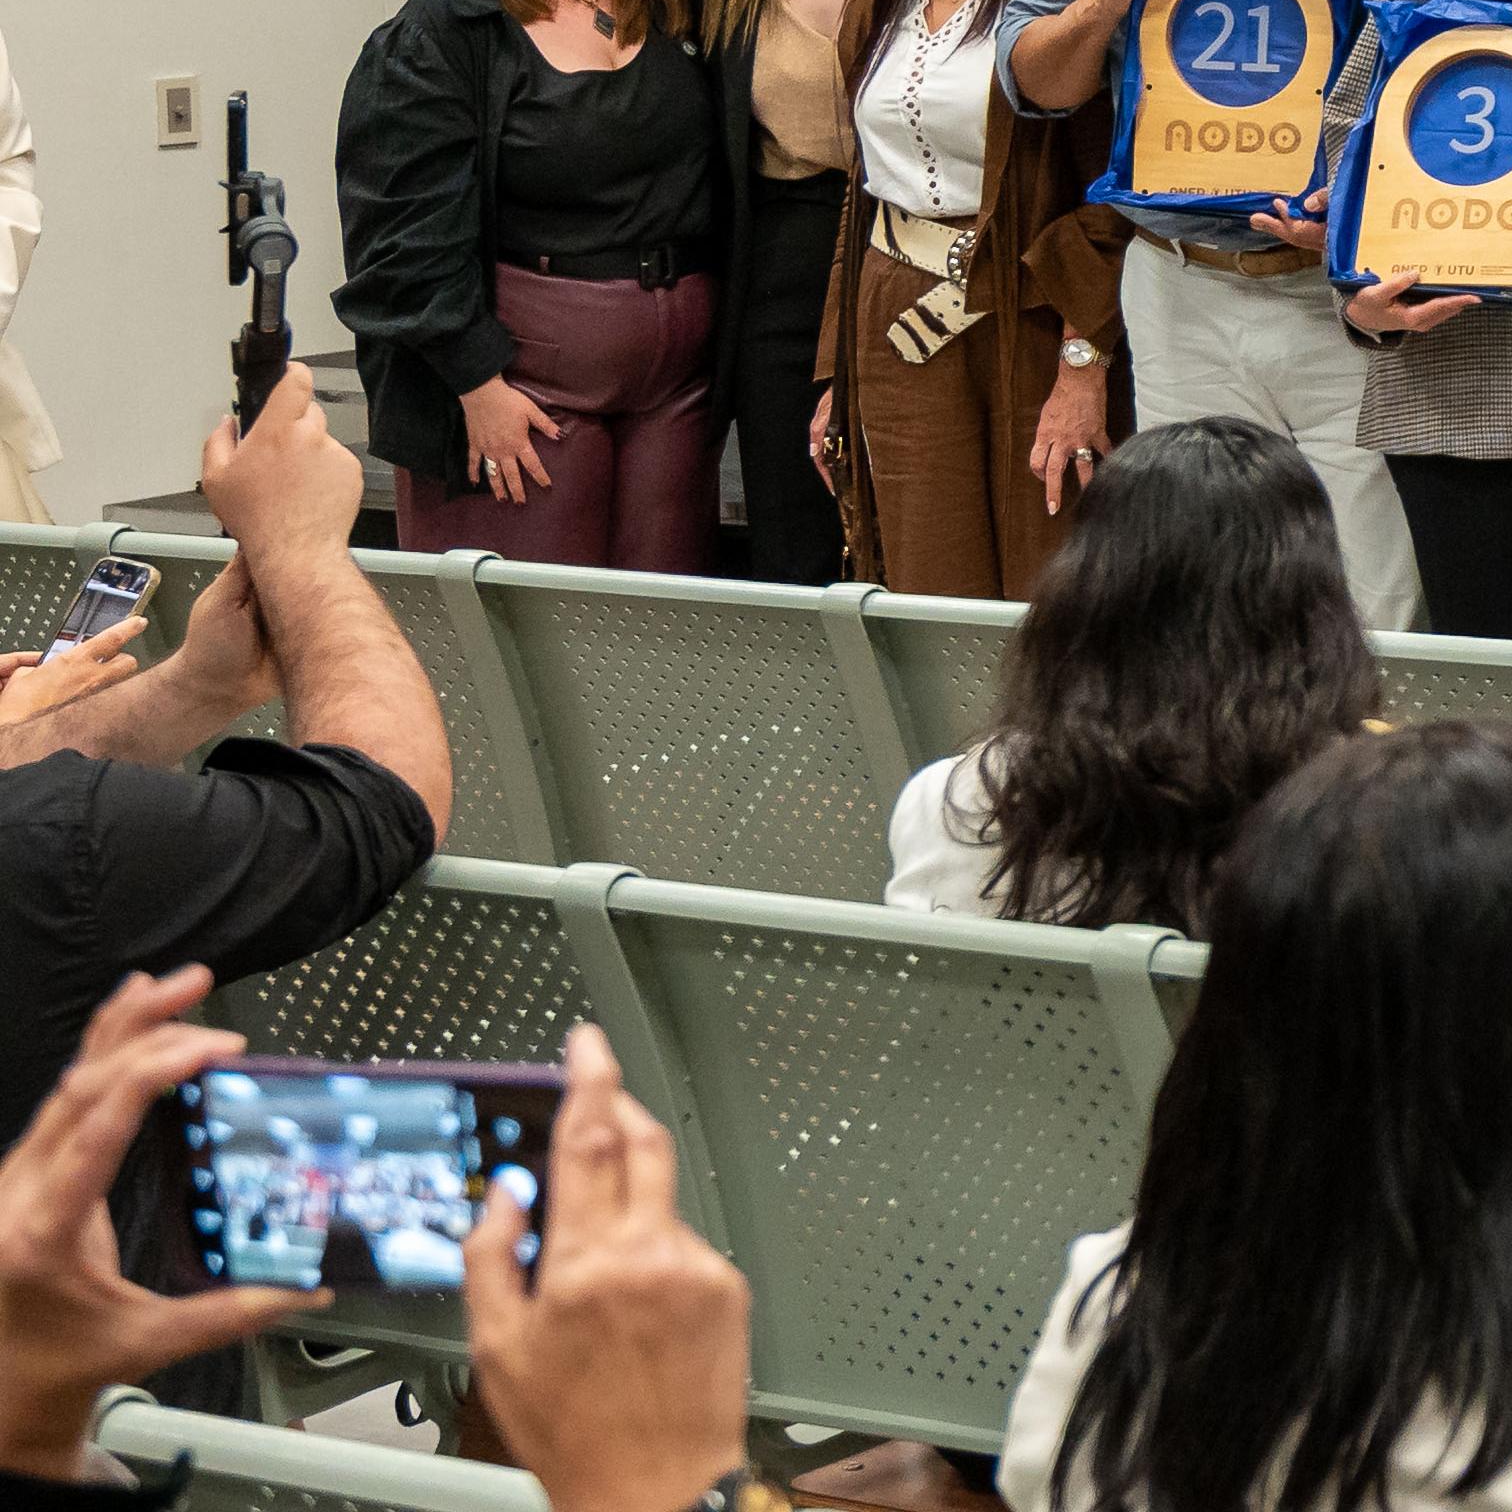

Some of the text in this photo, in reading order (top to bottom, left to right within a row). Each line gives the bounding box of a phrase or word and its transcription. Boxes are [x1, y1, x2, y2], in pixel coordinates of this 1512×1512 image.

[1191, 2, 1281, 73] 21
[1164, 119, 1302, 154] NODO
[1449, 86, 1496, 155] 3
[1448, 265, 1475, 276] UTU
